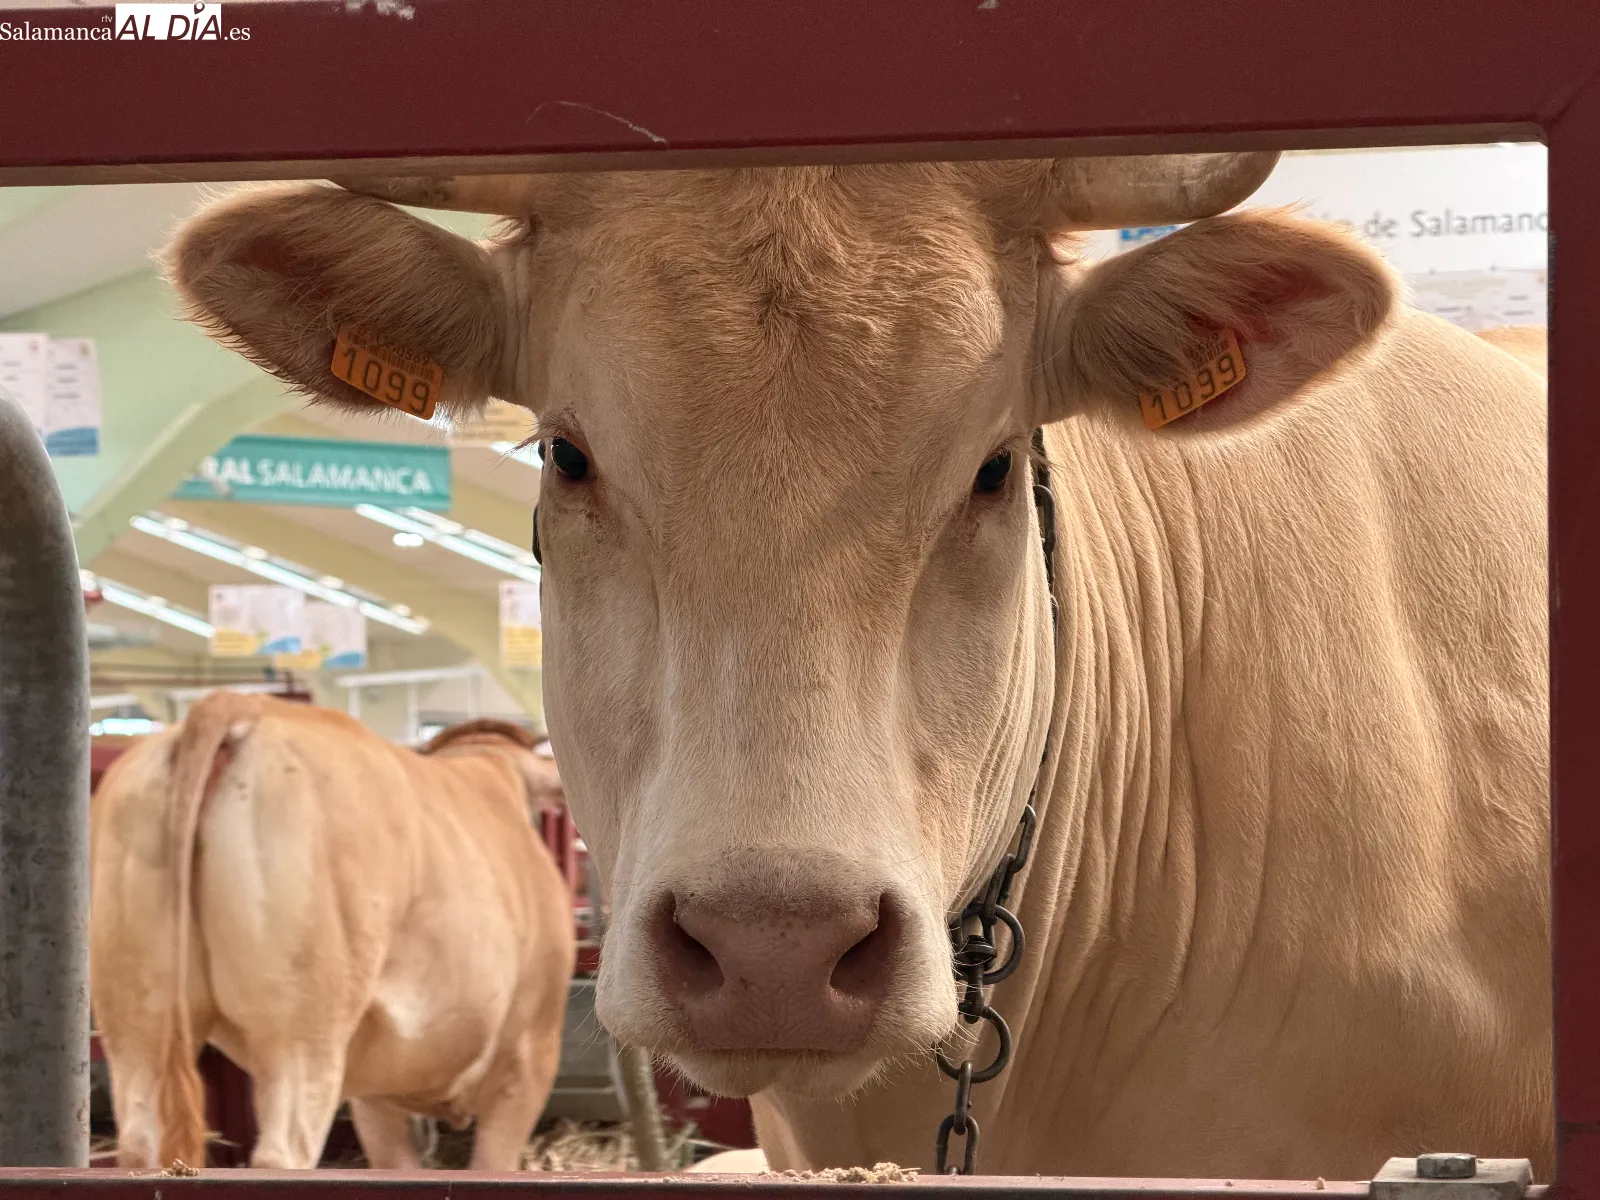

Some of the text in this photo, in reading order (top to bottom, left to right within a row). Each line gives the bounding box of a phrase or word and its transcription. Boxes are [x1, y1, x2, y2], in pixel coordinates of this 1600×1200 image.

[1365, 210, 1399, 238] de
[342, 346, 431, 414] 1099
[1151, 353, 1237, 421] 1099
[256, 458, 432, 495] SALAMANCA
